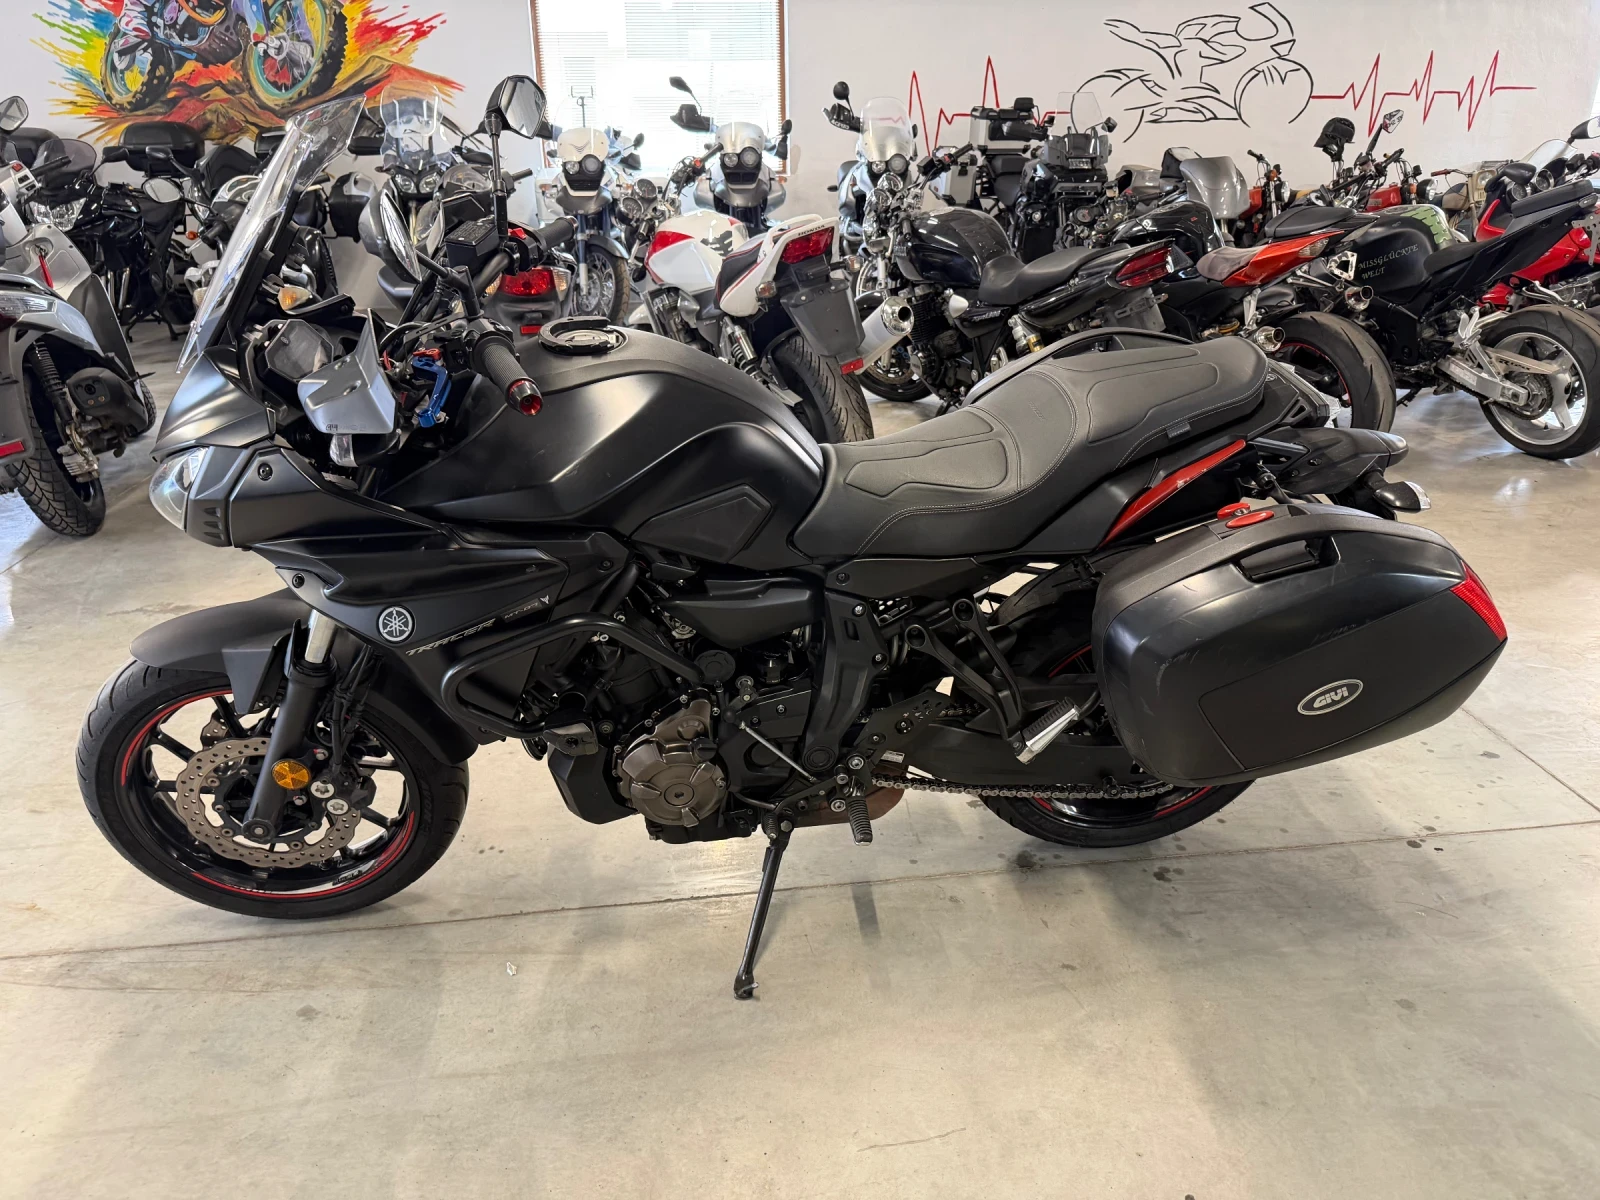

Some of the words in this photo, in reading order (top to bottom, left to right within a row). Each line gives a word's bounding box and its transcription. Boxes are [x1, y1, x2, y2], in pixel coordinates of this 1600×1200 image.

[798, 224, 826, 236] HONDA
[1362, 267, 1385, 279] WELT
[406, 618, 496, 656] TRACER
[504, 602, 539, 618] MT-07
[1313, 686, 1349, 708] GIVI
